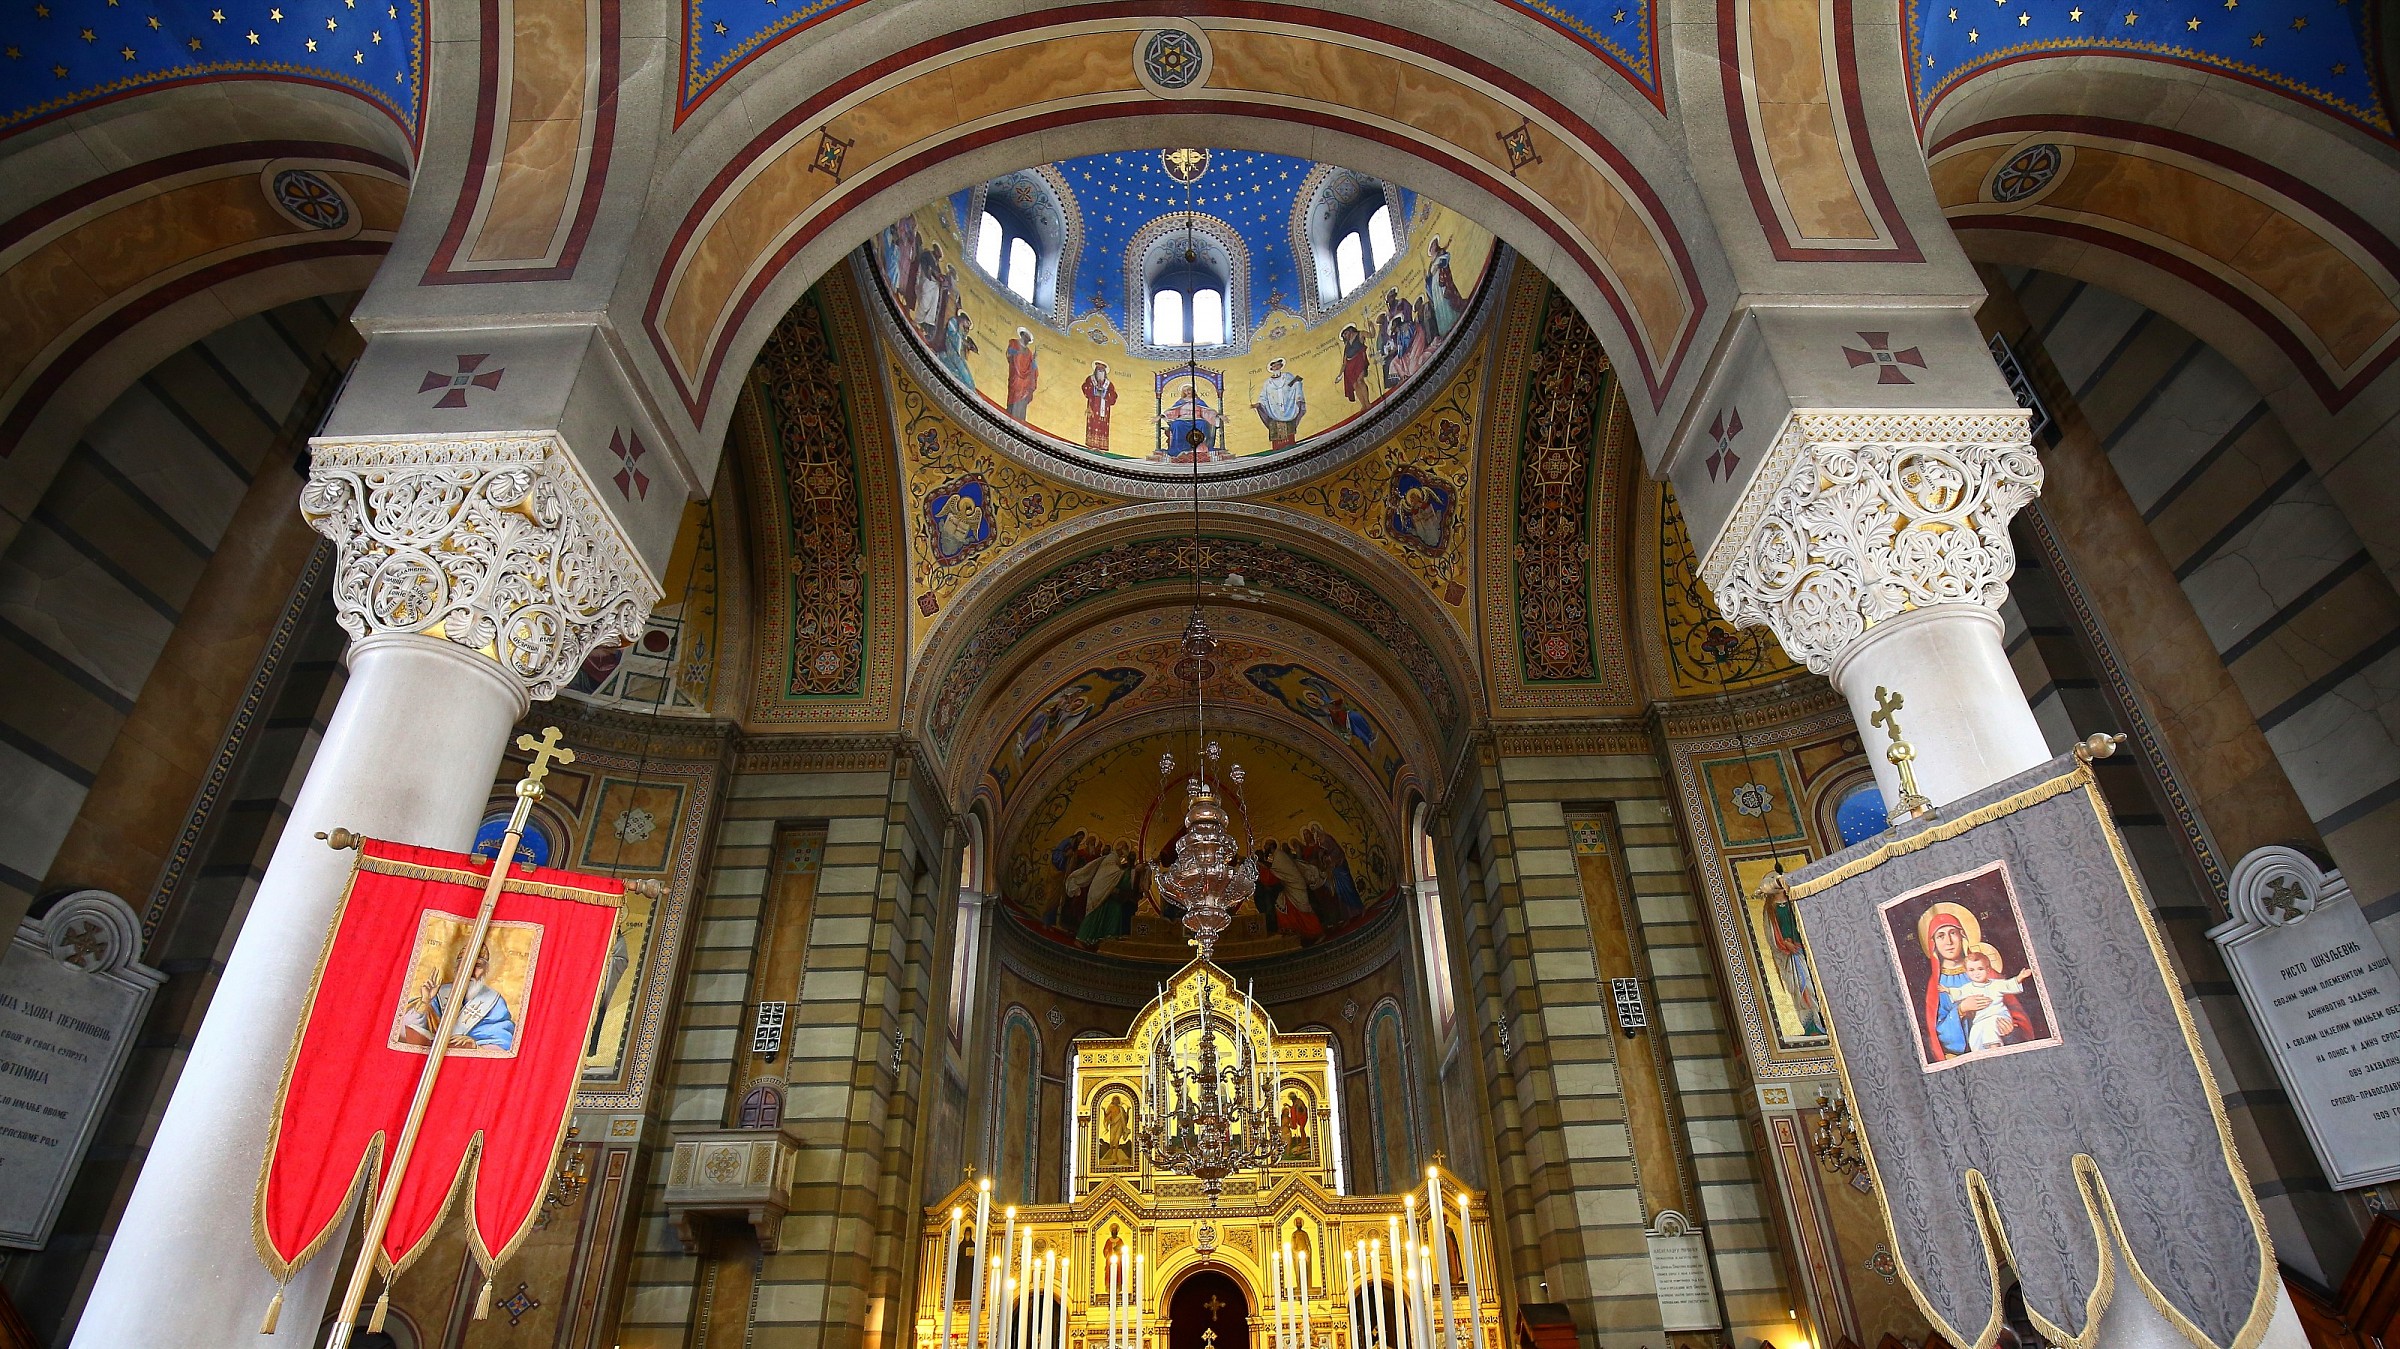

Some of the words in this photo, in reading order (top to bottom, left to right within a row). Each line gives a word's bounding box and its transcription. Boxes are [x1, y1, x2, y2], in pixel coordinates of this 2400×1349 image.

[2280, 962, 2307, 980] РИСТО
[2310, 941, 2361, 969] ШКУЉЕВИЋ
[2273, 993, 2298, 1007] СВОЈИМ
[2299, 985, 2319, 998] УМОМ
[2320, 967, 2365, 990] ПЛЕМЕНИТОМ
[21, 1001, 54, 1022] УДОВА
[2307, 998, 2346, 1019] ДОЖИВОТНО
[2285, 1042, 2292, 1050] А
[2292, 1033, 2318, 1048] СВОЈИМ
[2319, 1022, 2351, 1038] ЦИЈЕЛИМ
[2353, 1010, 2385, 1027] ИМАЊЕМ
[25, 1036, 32, 1046] И
[2316, 1055, 2323, 1063] НА
[2327, 1046, 2349, 1060] ПОНОС
[2349, 1067, 2363, 1078] ОВУ
[2373, 1110, 2390, 1120] 1909
